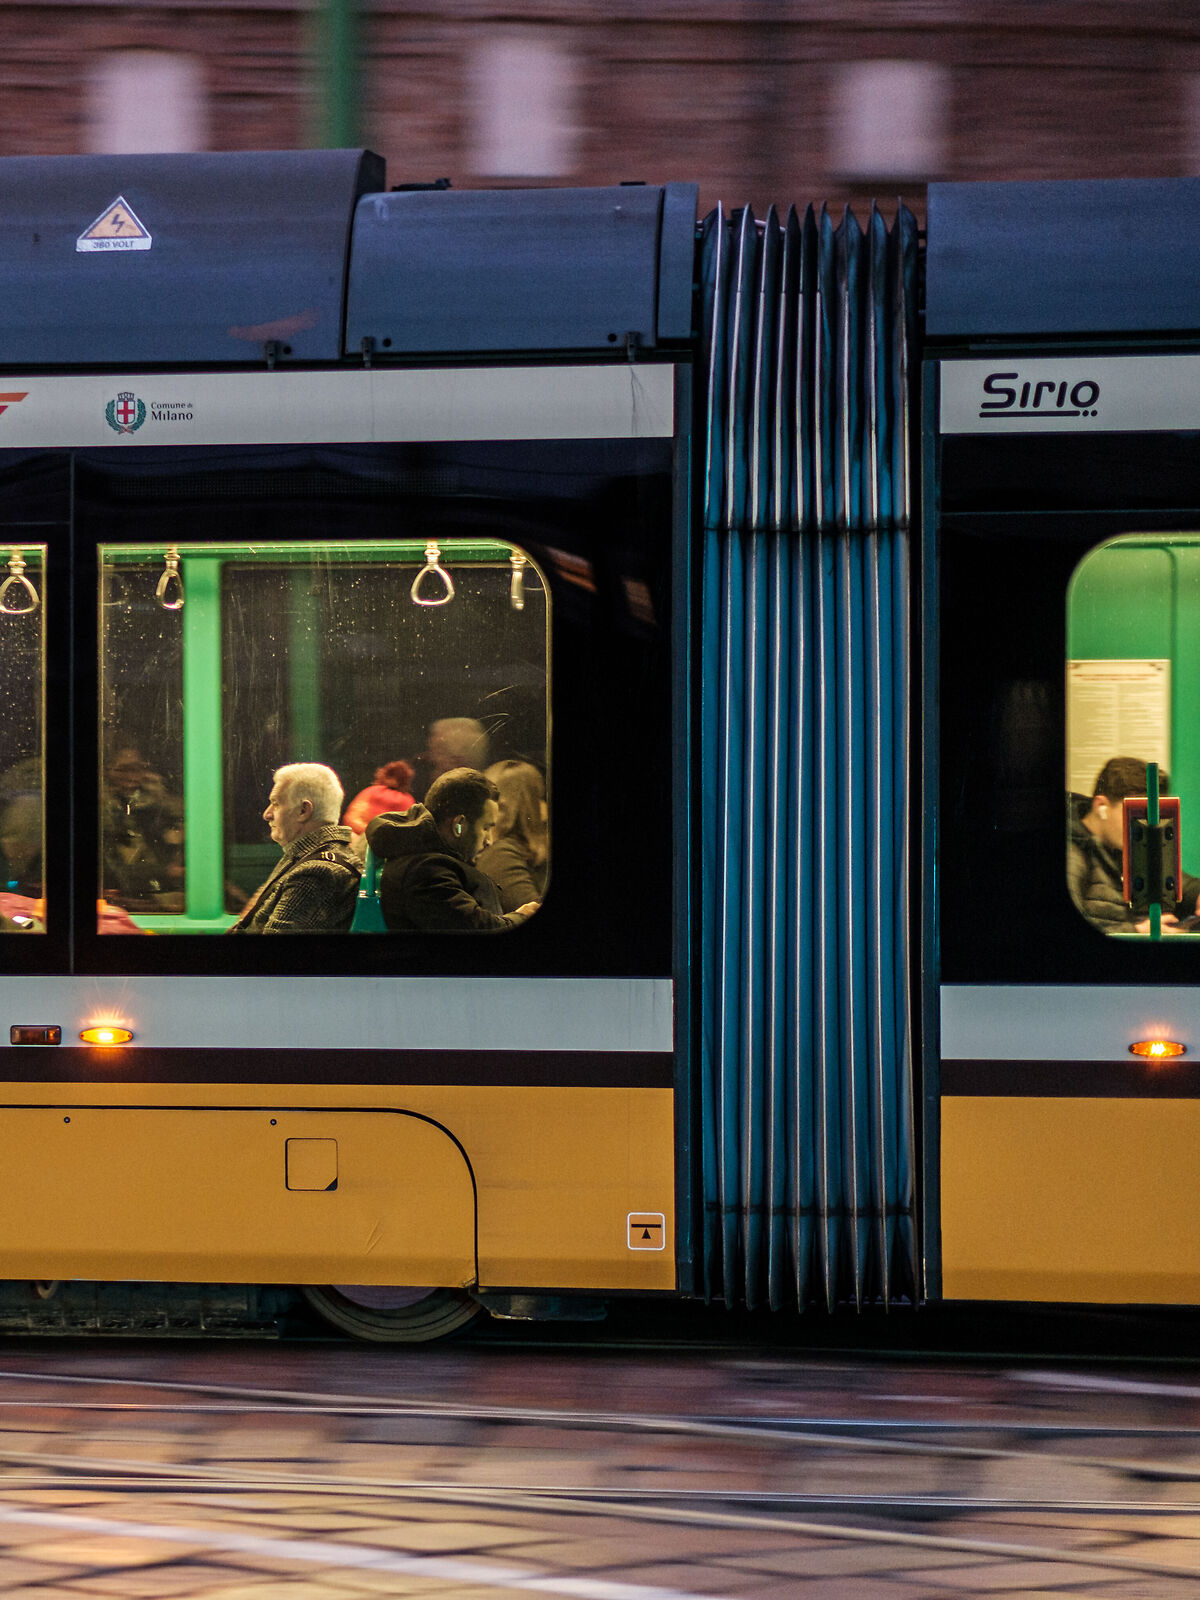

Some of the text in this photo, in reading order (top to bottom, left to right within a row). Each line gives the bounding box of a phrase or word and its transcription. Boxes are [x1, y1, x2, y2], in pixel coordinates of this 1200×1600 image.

[93, 241, 135, 249] 380 VOLT
[151, 402, 186, 410] Comune
[151, 410, 193, 421] Milano
